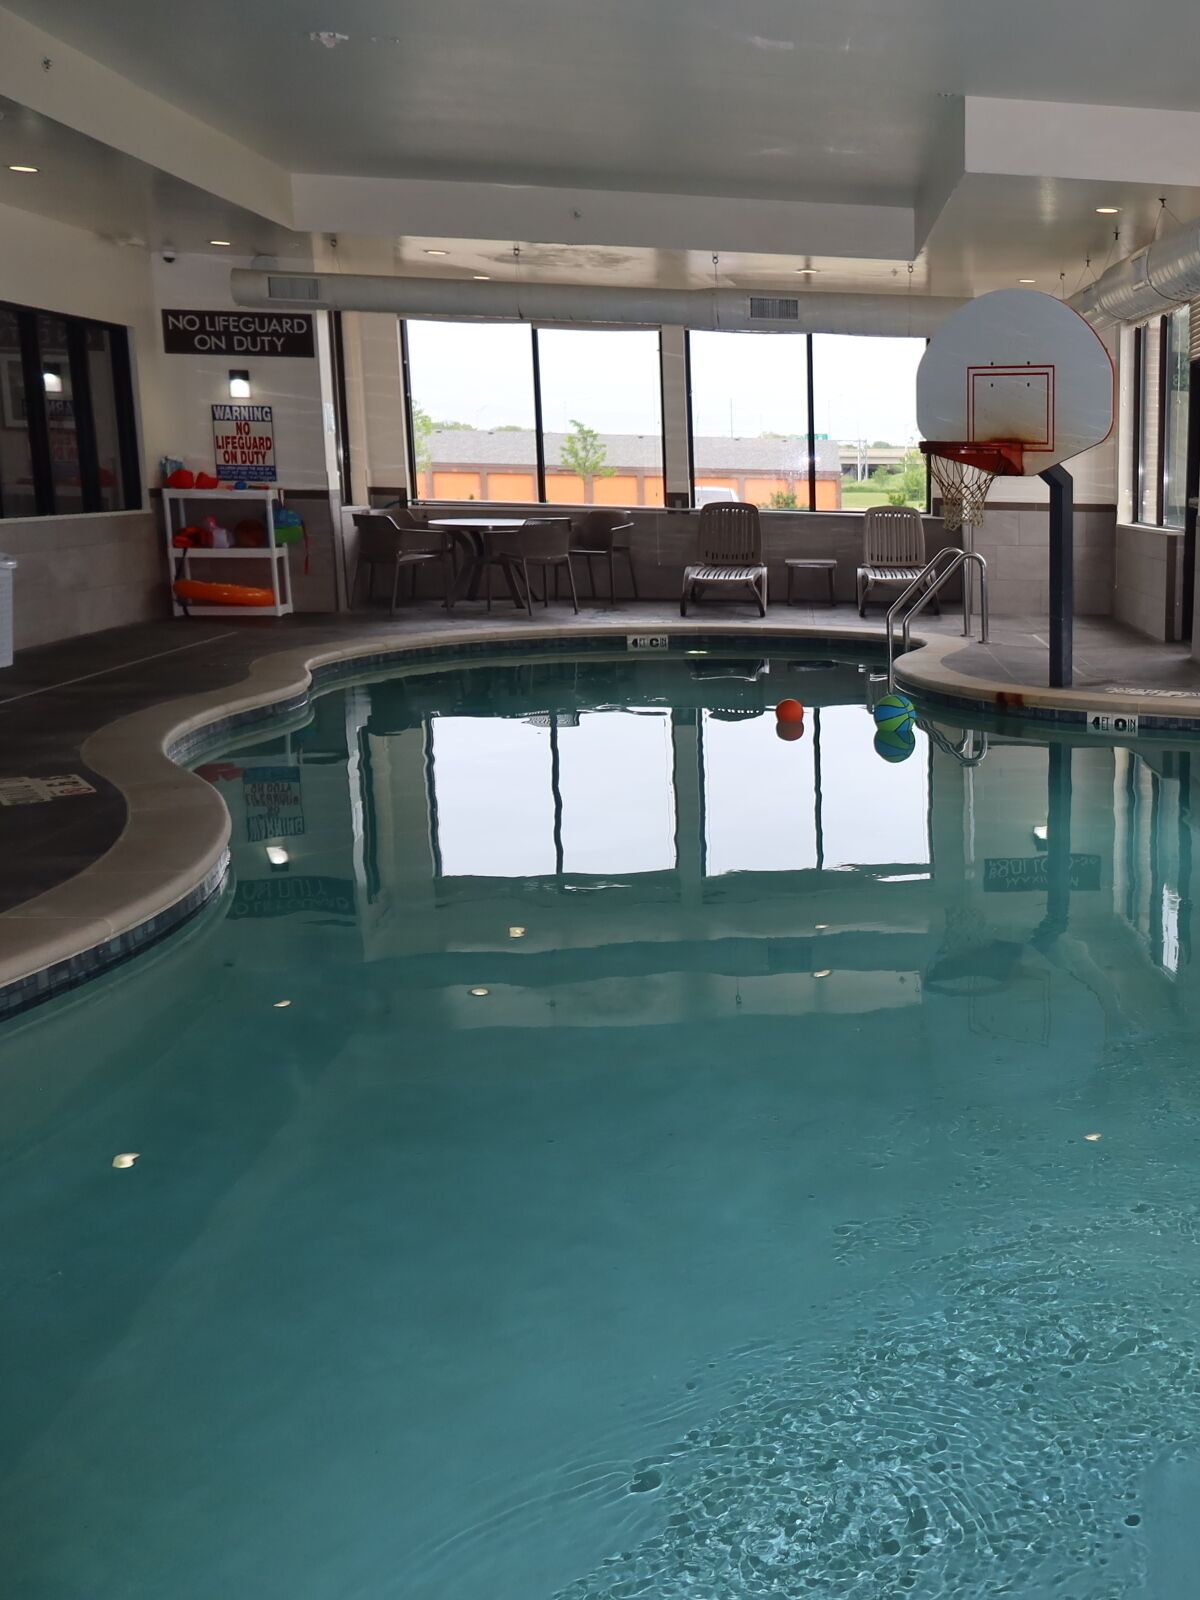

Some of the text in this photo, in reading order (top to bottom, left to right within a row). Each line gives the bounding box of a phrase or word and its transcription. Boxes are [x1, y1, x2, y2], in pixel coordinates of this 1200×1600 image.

[168, 315, 307, 334] NO LIFEGUARD
[194, 334, 285, 352] ON DUTY
[213, 405, 271, 421] WARNING
[236, 421, 250, 436] NO
[215, 435, 272, 451] LIFEGUARD
[223, 450, 266, 465] ON DUTY
